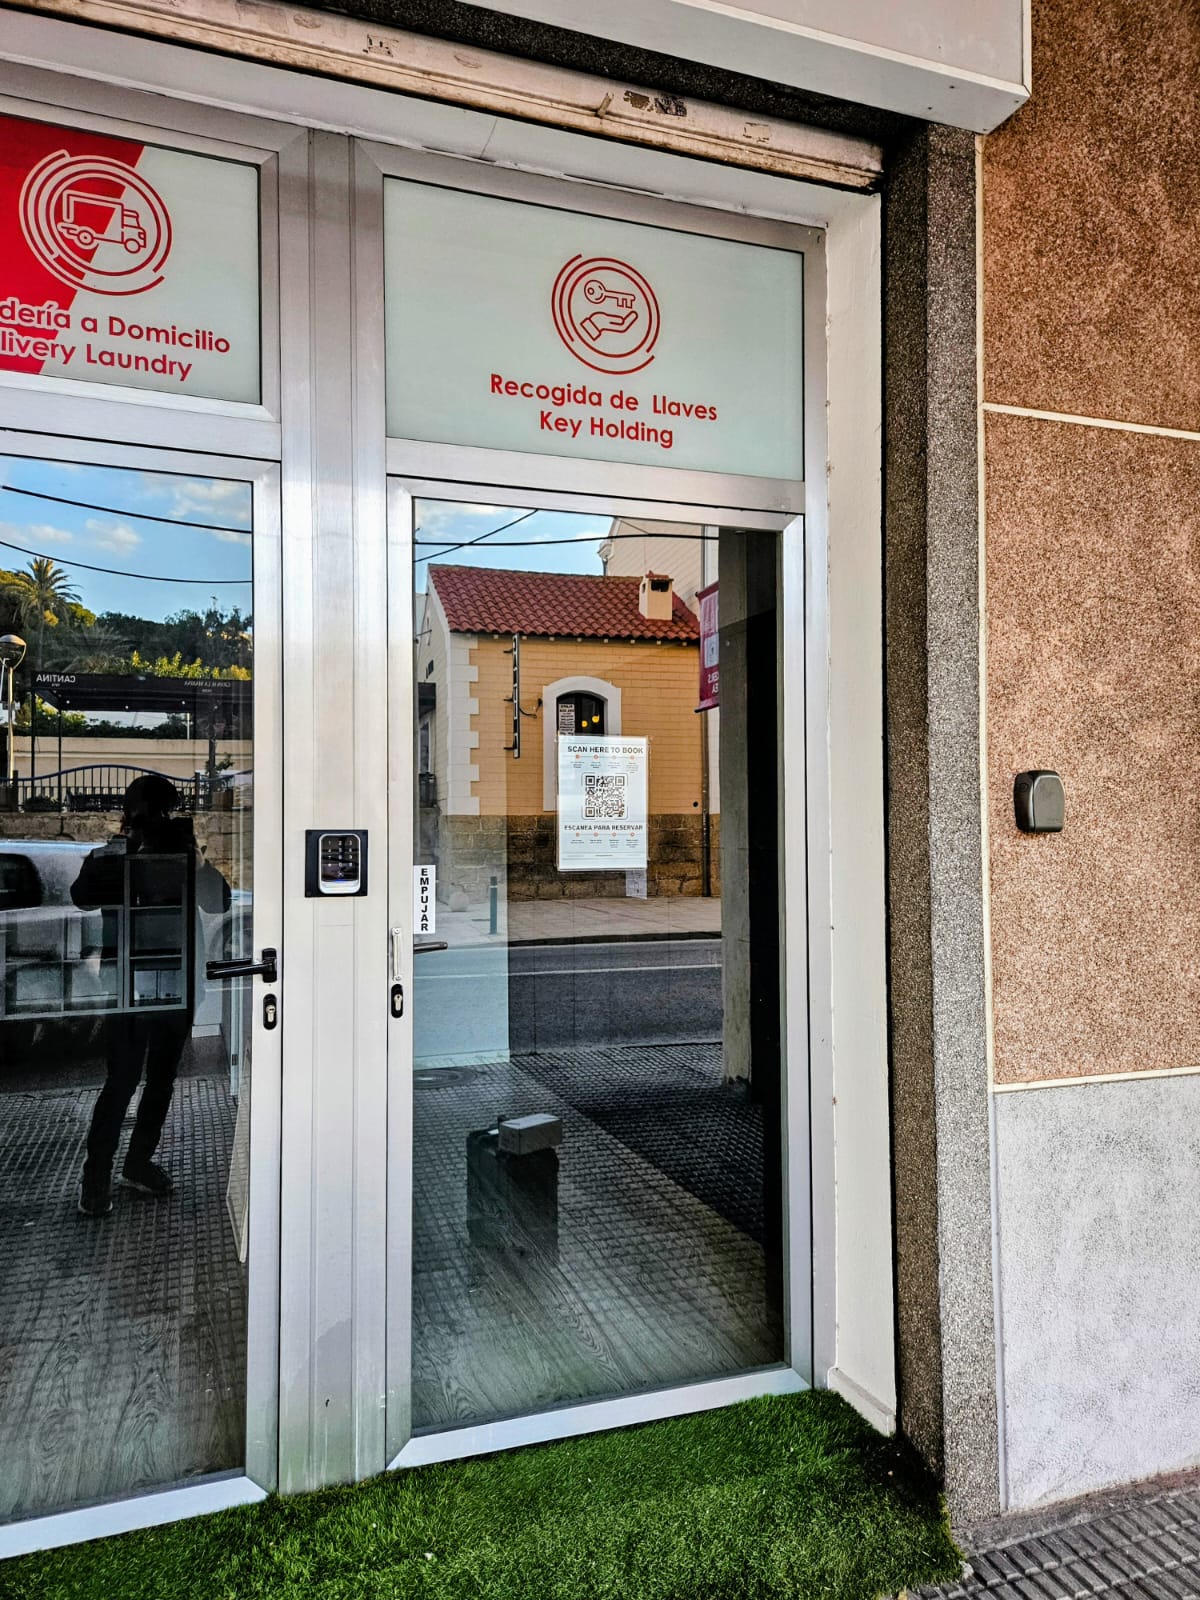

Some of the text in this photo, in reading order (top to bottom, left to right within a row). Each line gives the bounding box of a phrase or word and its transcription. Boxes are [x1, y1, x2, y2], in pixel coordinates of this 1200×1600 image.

[81, 316, 98, 333] a
[108, 316, 231, 353] Domicilio
[86, 343, 193, 382] Laundry
[490, 373, 718, 421] Recogida de Llaves
[540, 410, 673, 449] Key Holding
[567, 745, 644, 754] SCAN HERE TO BOOK
[420, 868, 429, 932] EMPUJAR
